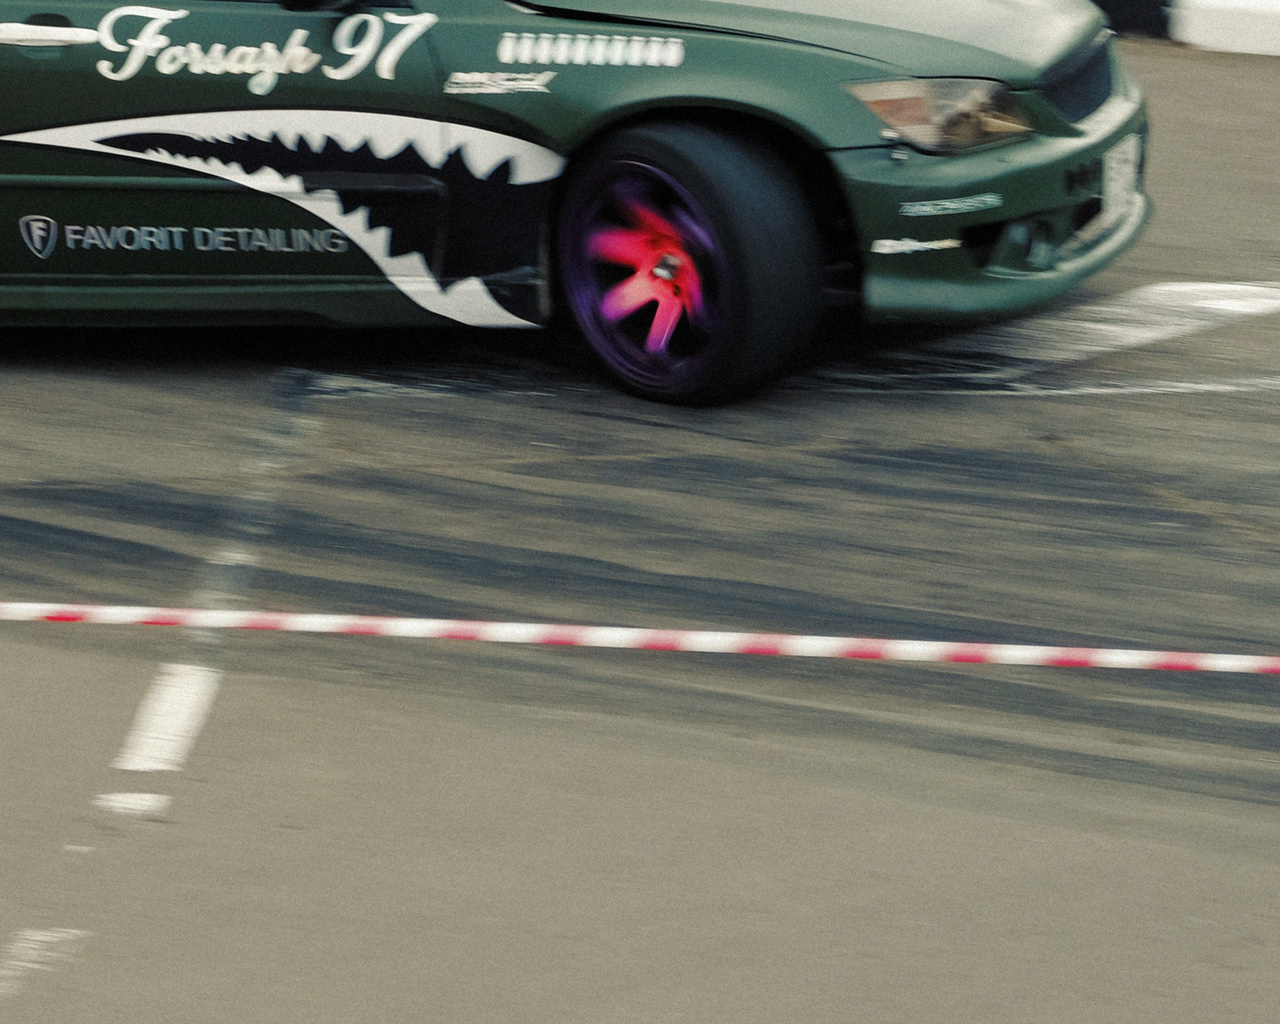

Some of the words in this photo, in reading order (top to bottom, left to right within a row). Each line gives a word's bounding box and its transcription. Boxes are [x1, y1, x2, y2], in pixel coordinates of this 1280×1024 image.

[322, 12, 440, 81] 97
[65, 225, 188, 251] FAVORIT
[194, 227, 348, 253] DETAILING
